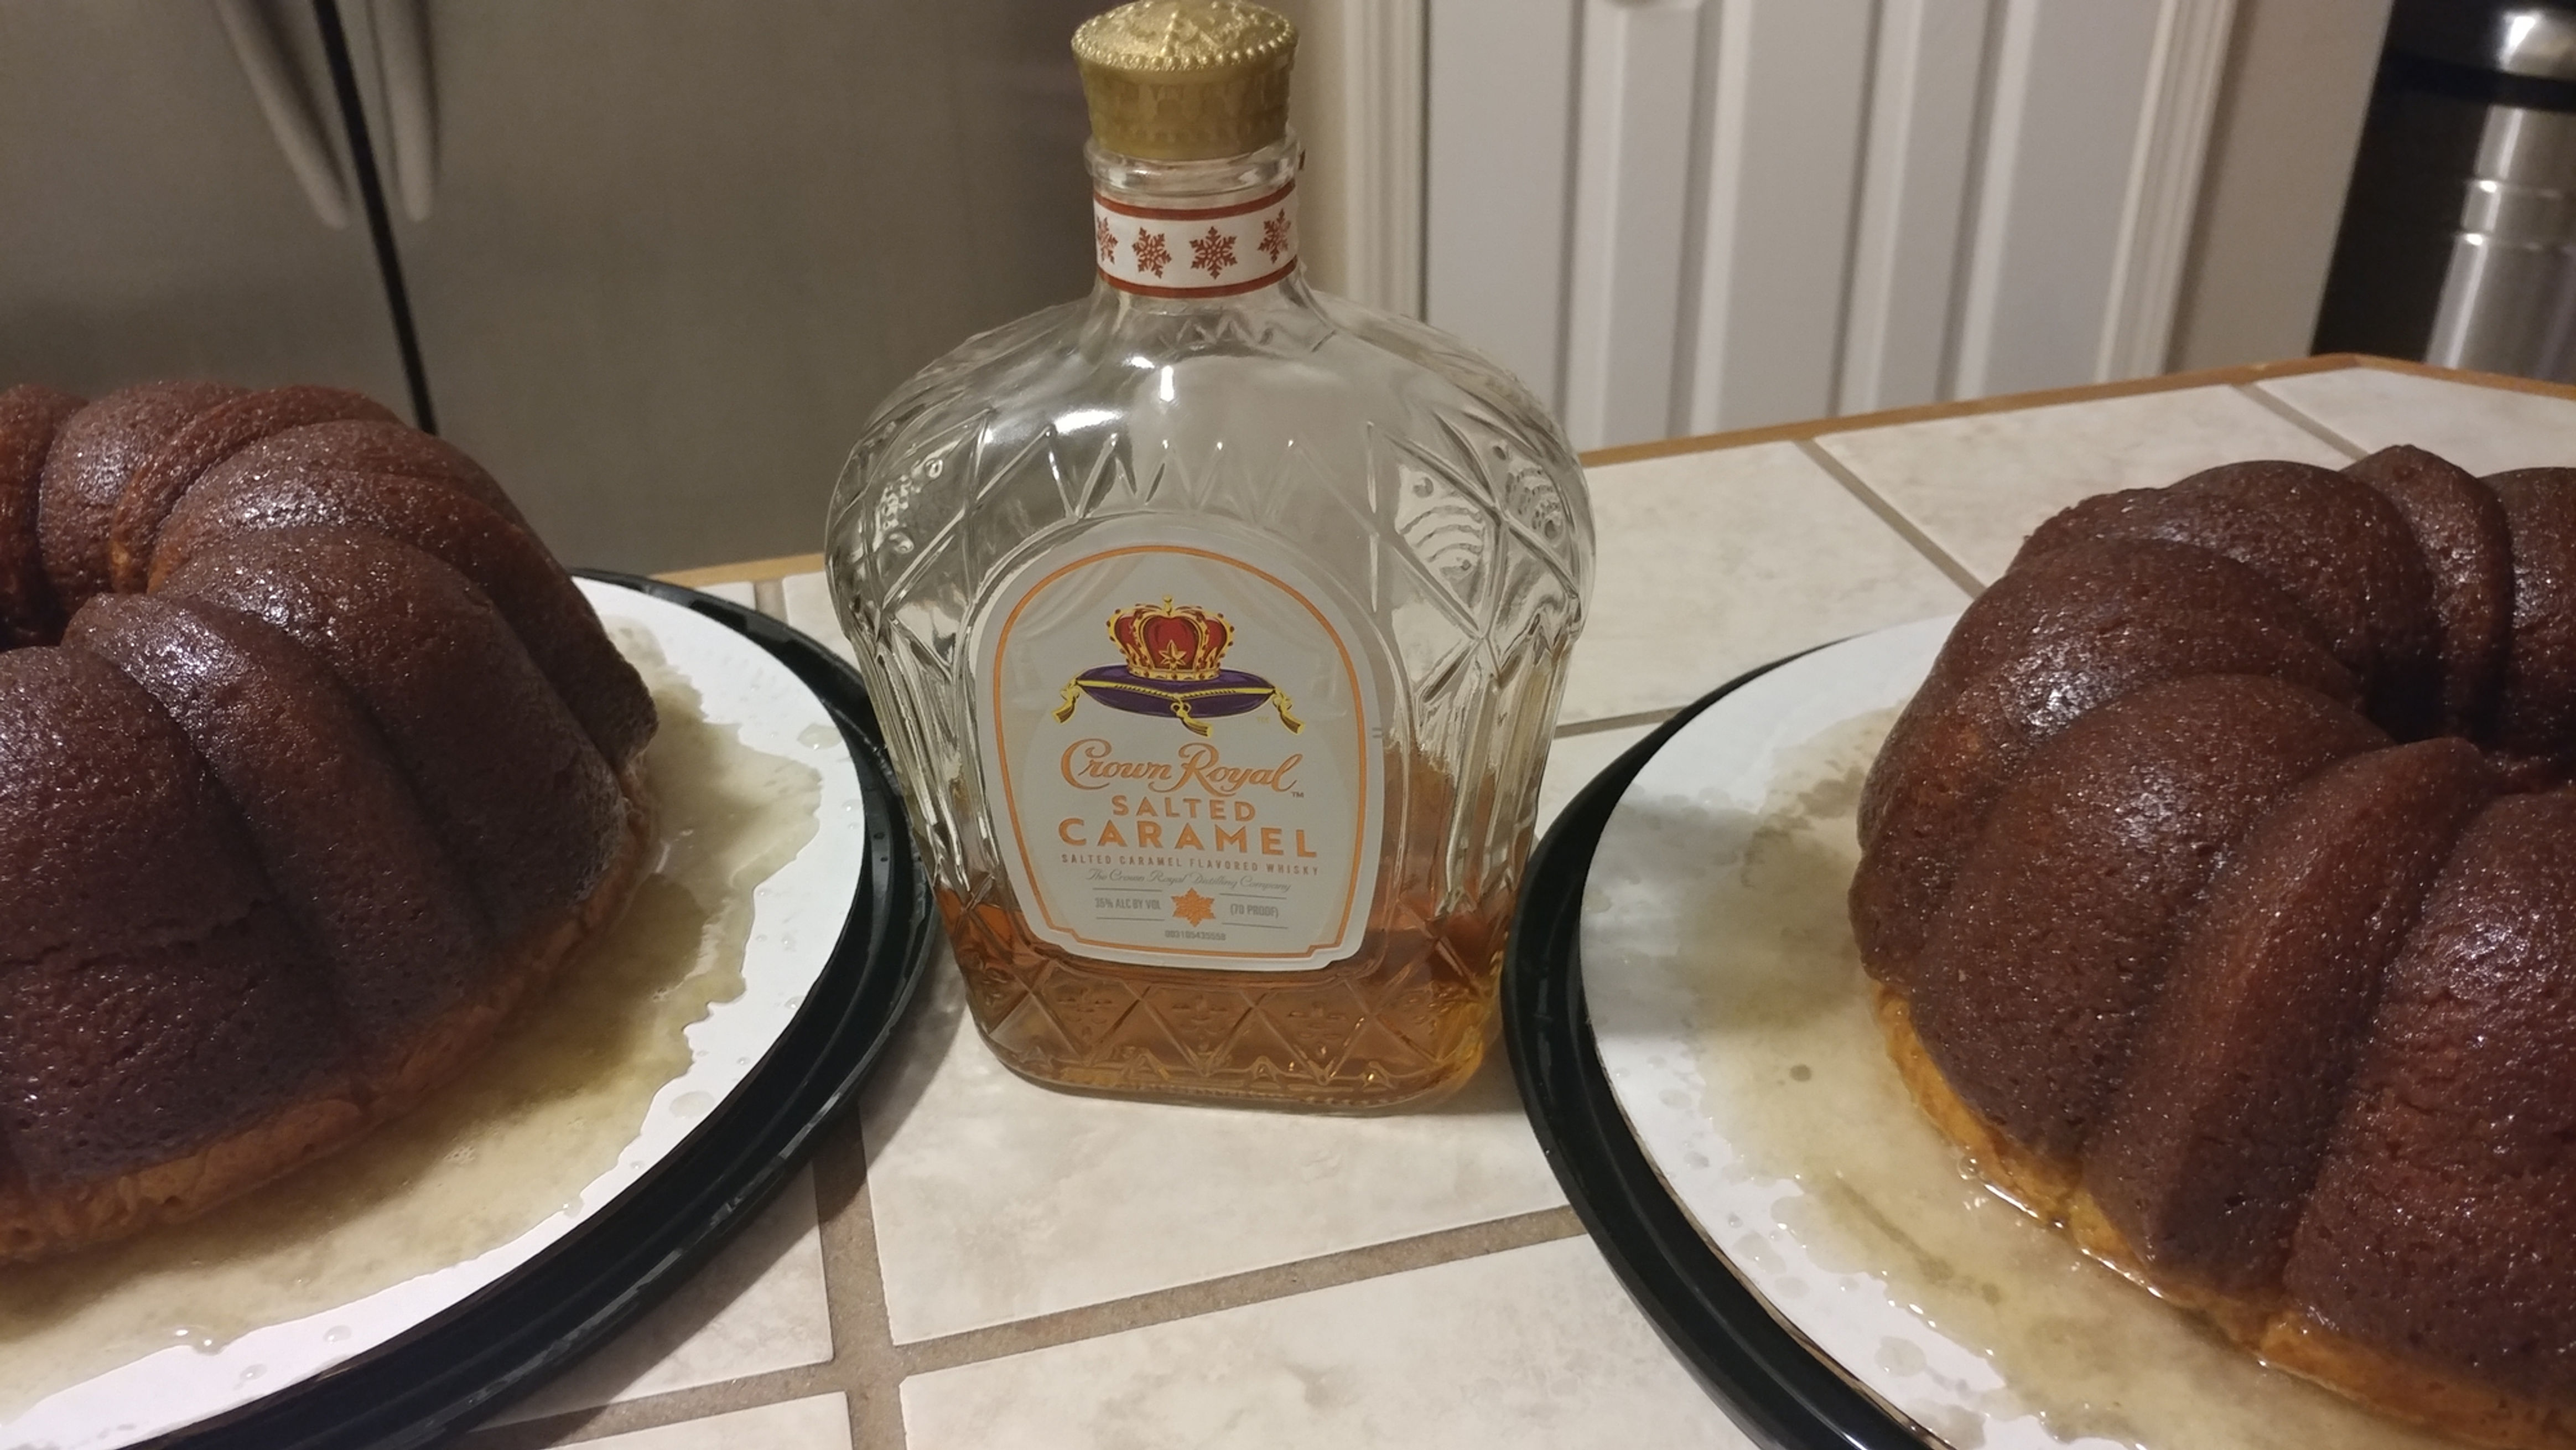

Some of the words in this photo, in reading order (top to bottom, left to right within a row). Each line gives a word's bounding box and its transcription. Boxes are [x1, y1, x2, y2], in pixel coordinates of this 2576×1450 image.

[1061, 738, 1172, 790] Crown
[1148, 742, 1303, 797] Royal
[1112, 795, 1255, 821] SALTED
[1058, 818, 1317, 858] CARAMEL
[1061, 854, 1112, 864] SALTED
[1119, 856, 1182, 867] CARAMEL
[1190, 858, 1259, 872] FLAVORED
[1266, 863, 1318, 876] WHISKY
[1086, 868, 1107, 881] The
[1109, 868, 1145, 882] Crown
[1146, 869, 1188, 886] Royal
[1186, 872, 1238, 889] Distilling
[1239, 876, 1291, 894] Company
[1095, 897, 1113, 908] 35%
[1115, 898, 1131, 908] ALC
[1132, 899, 1143, 909] BY
[1145, 899, 1161, 910] VOL
[1247, 904, 1279, 919] PROOF)
